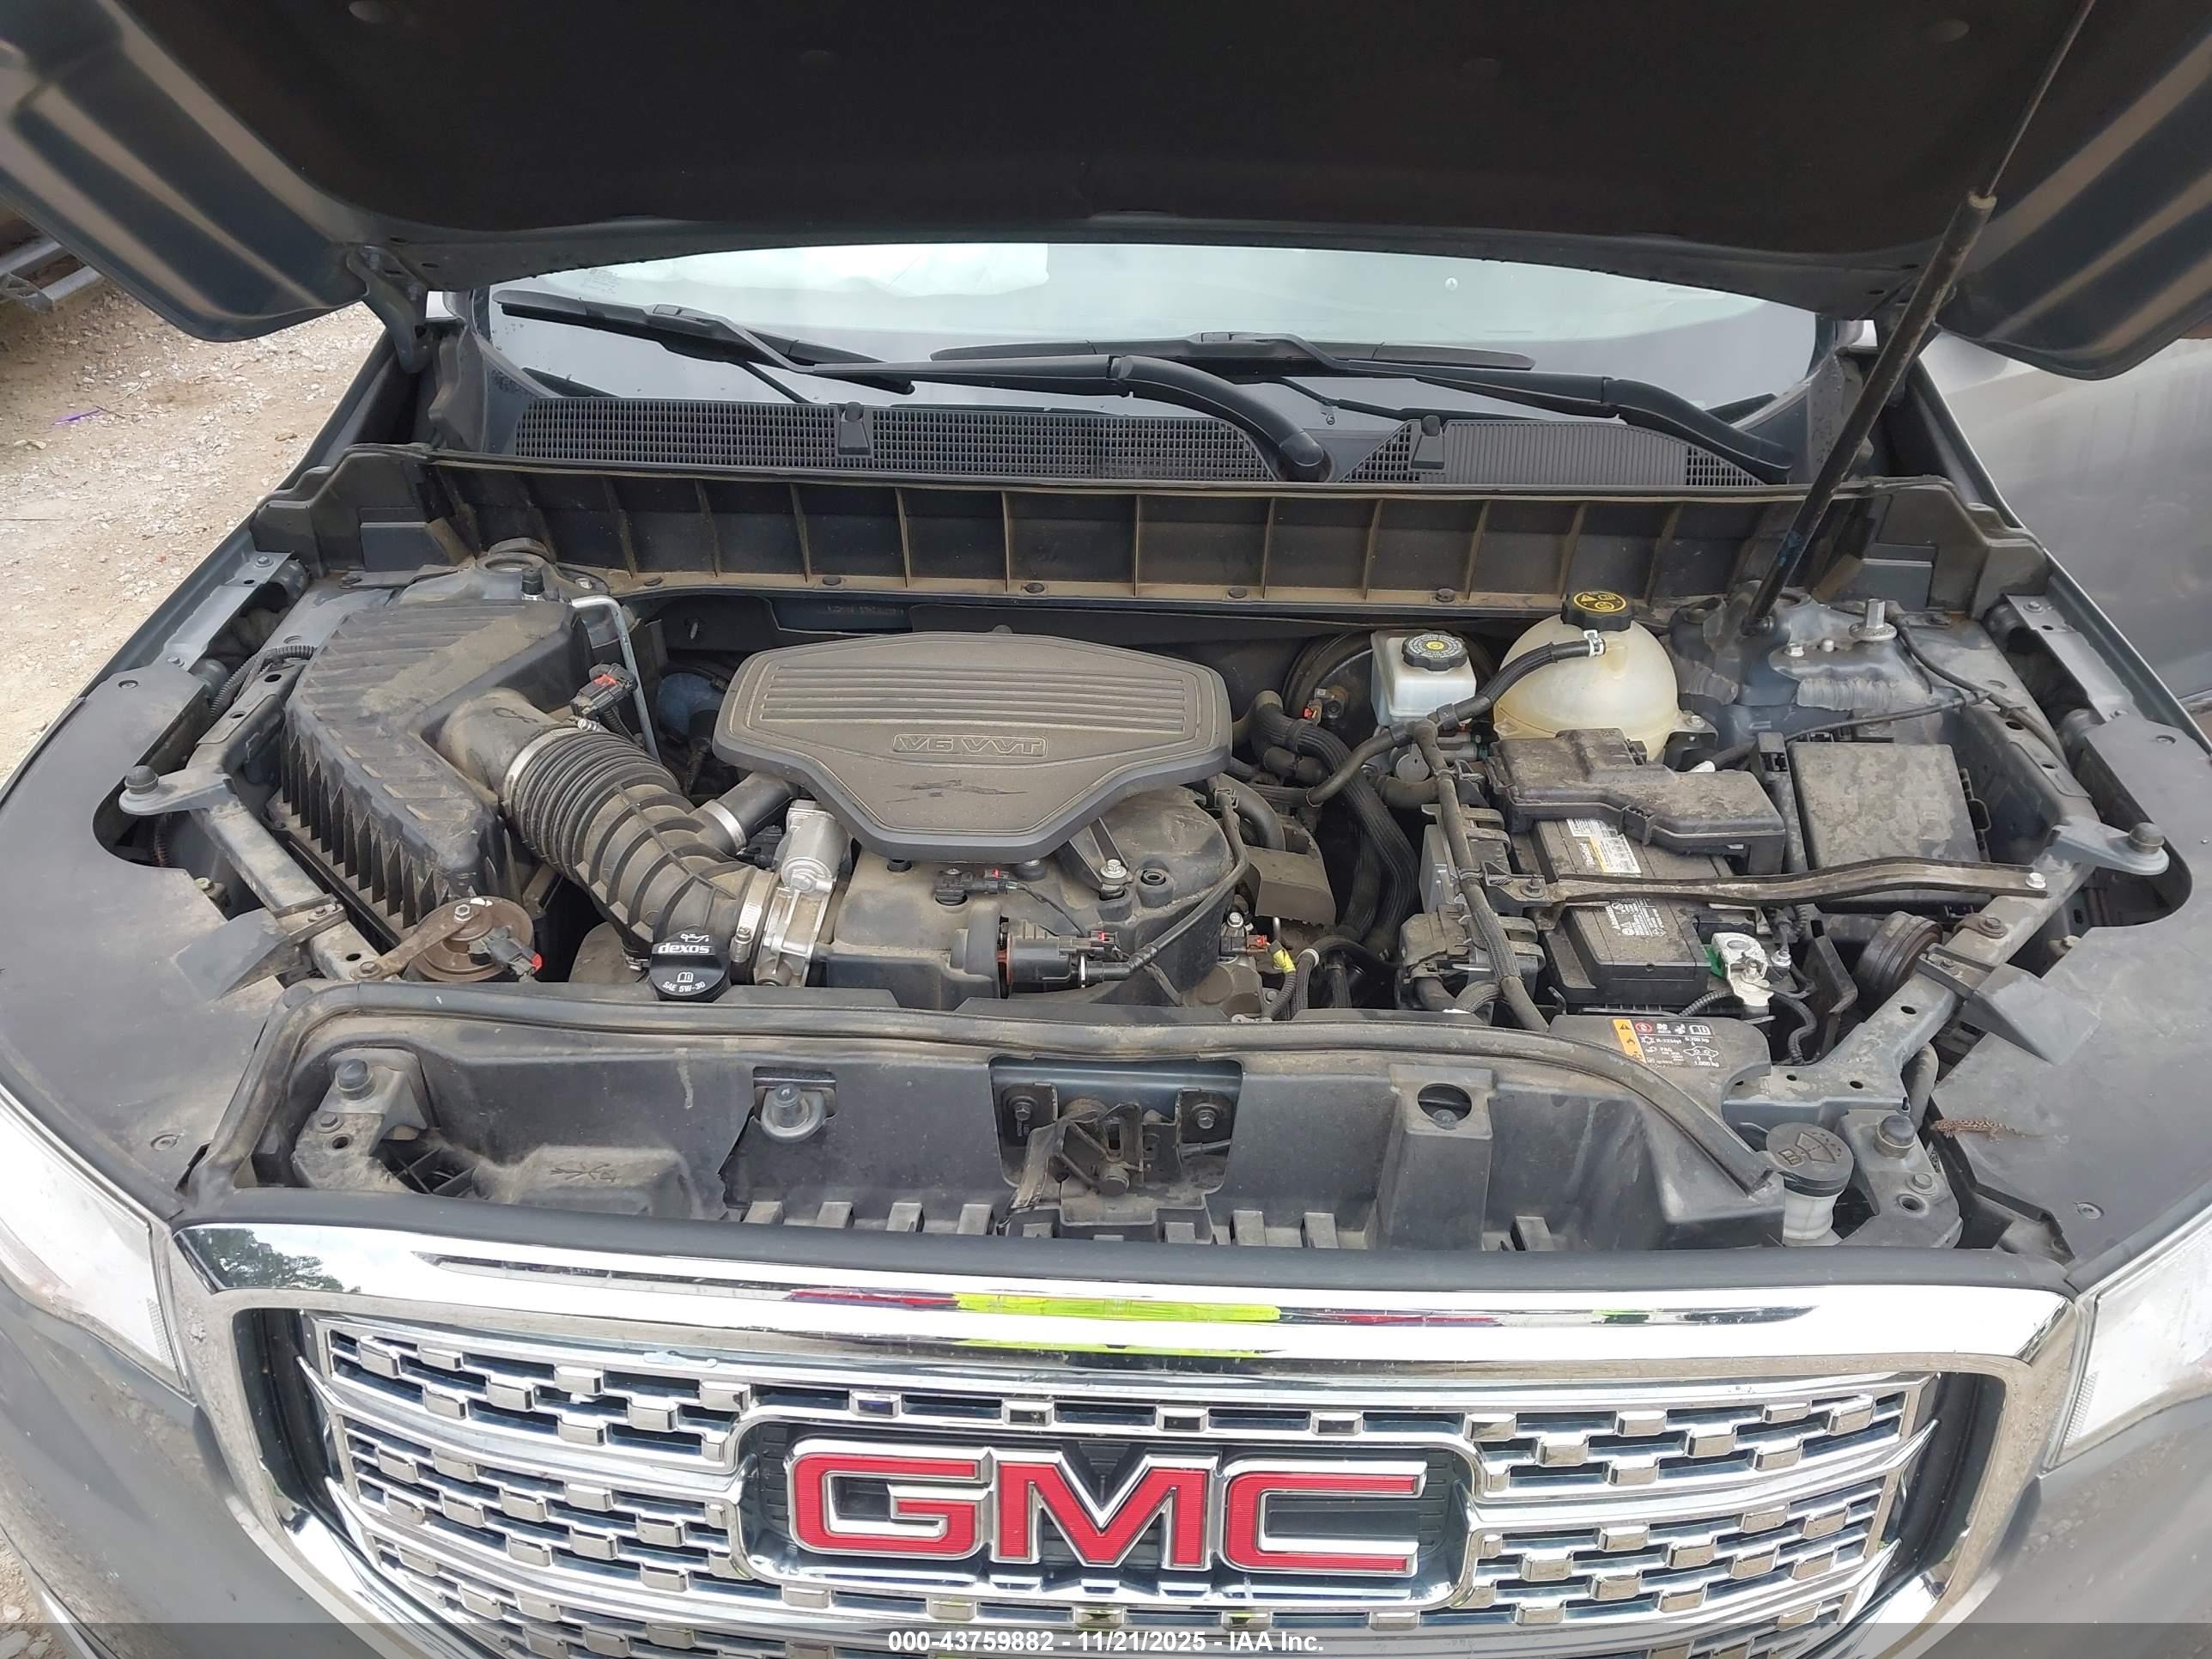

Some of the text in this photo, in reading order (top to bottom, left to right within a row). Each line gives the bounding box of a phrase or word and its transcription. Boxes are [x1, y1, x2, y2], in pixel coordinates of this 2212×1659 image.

[900, 737, 1041, 755] V6 VVT
[658, 943, 710, 953] dexos
[662, 981, 706, 993] SAE 5W-30
[787, 1439, 1428, 1577] GMC
